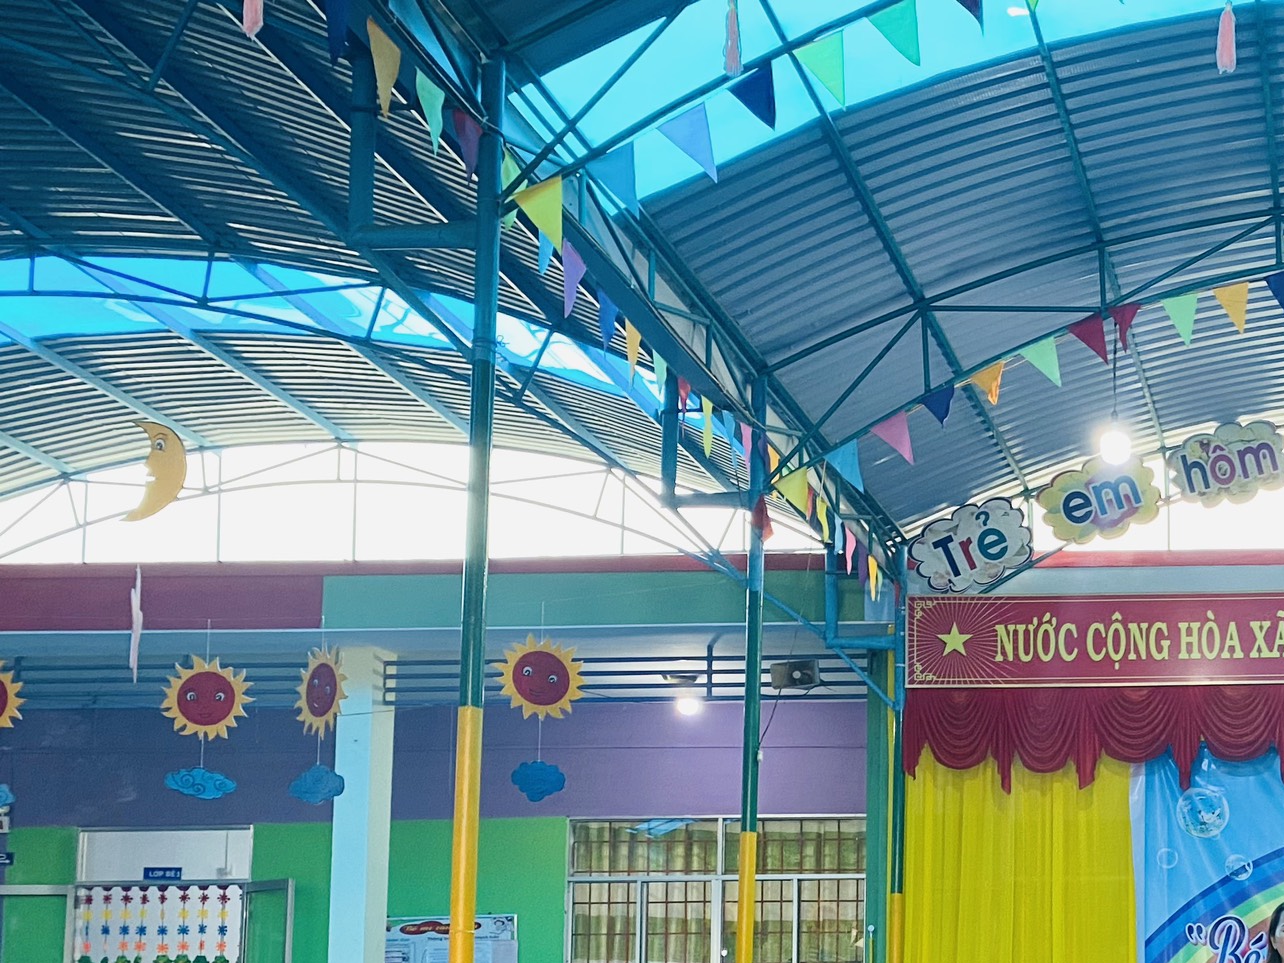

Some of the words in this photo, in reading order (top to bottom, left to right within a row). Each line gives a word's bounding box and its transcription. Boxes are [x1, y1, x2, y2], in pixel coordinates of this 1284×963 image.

[932, 509, 1009, 580] Trẻ
[1061, 475, 1143, 526] em
[1181, 440, 1280, 495] hôm
[995, 612, 1078, 663] NƯỚC
[1086, 610, 1169, 676] CỘNG
[1178, 607, 1244, 661] HÒA
